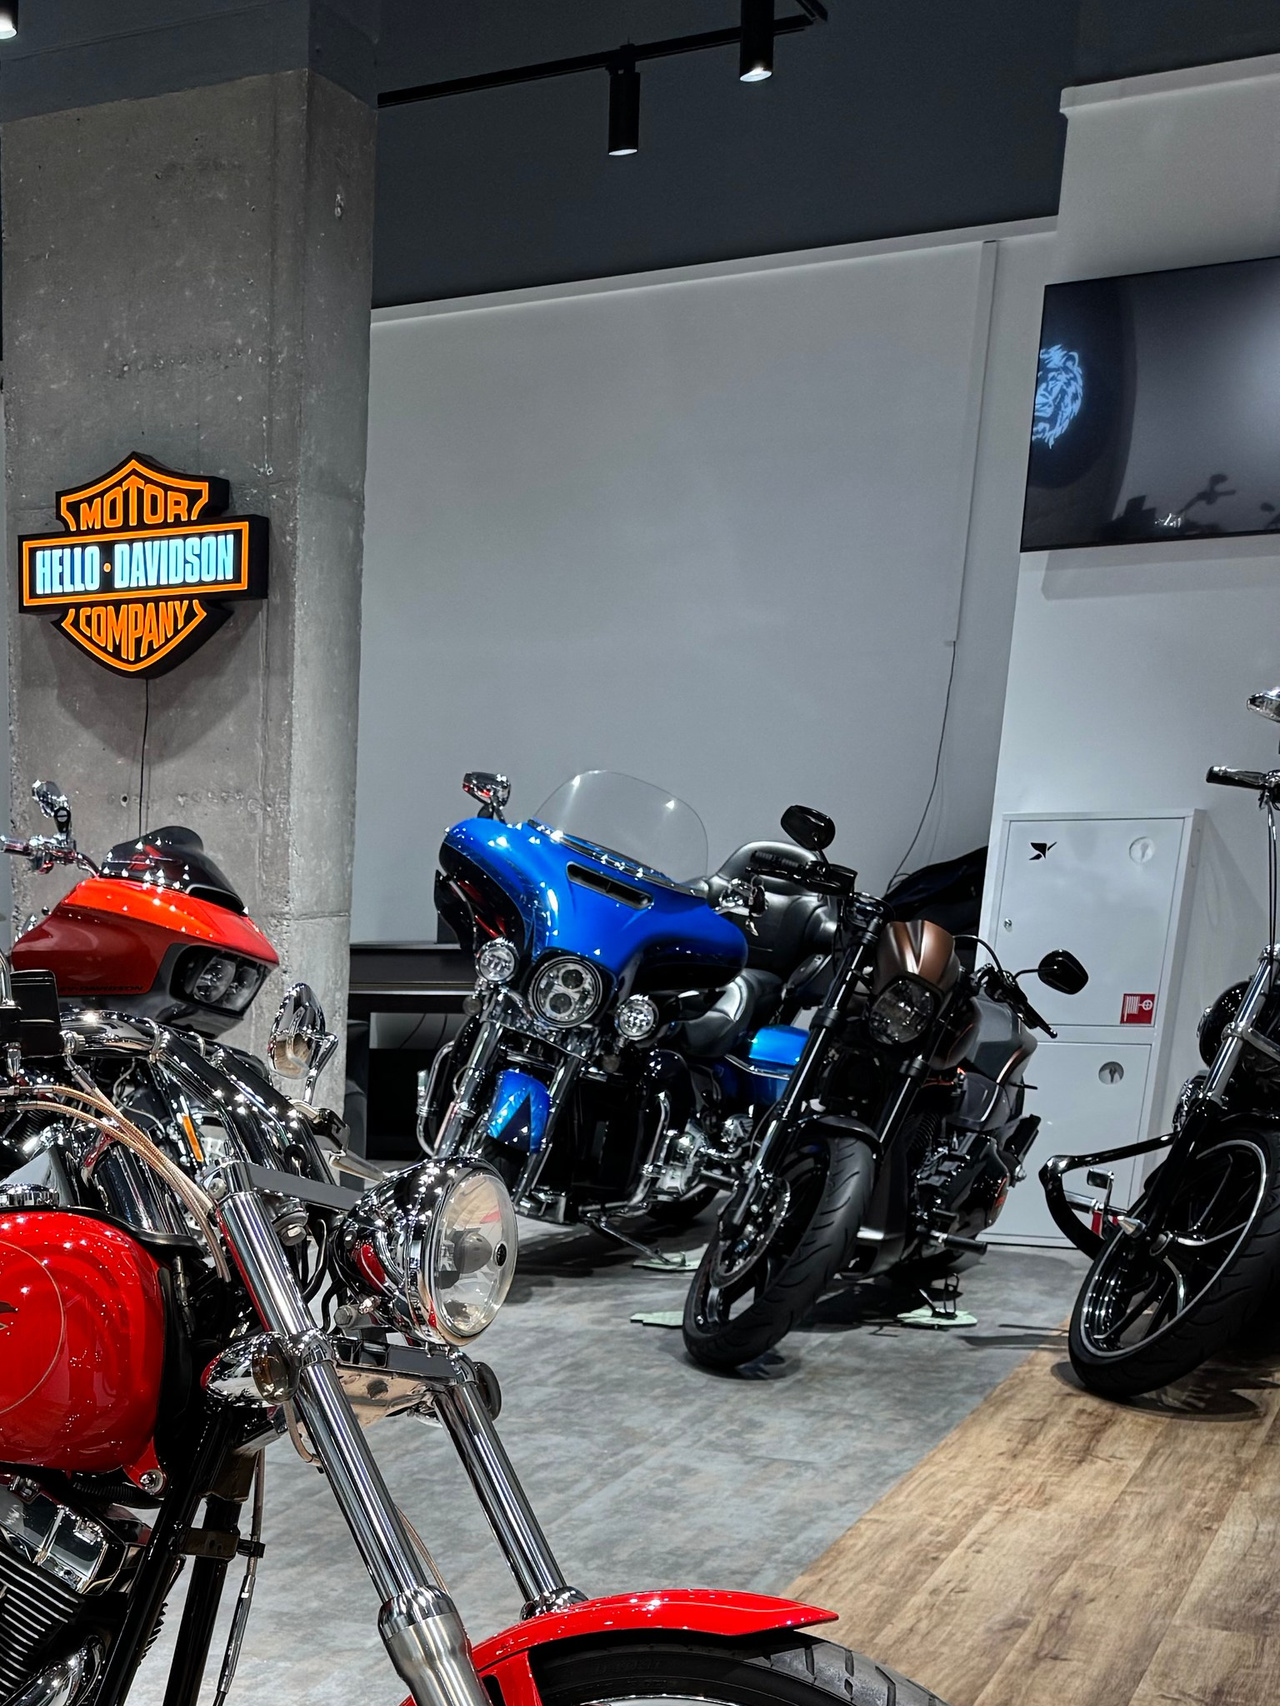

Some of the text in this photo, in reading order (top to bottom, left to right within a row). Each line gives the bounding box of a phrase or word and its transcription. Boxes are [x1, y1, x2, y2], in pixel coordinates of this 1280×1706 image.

[79, 475, 188, 530] MOTOR
[35, 534, 235, 594] HELLO DAVIDSON
[78, 599, 189, 661] COMPANY
